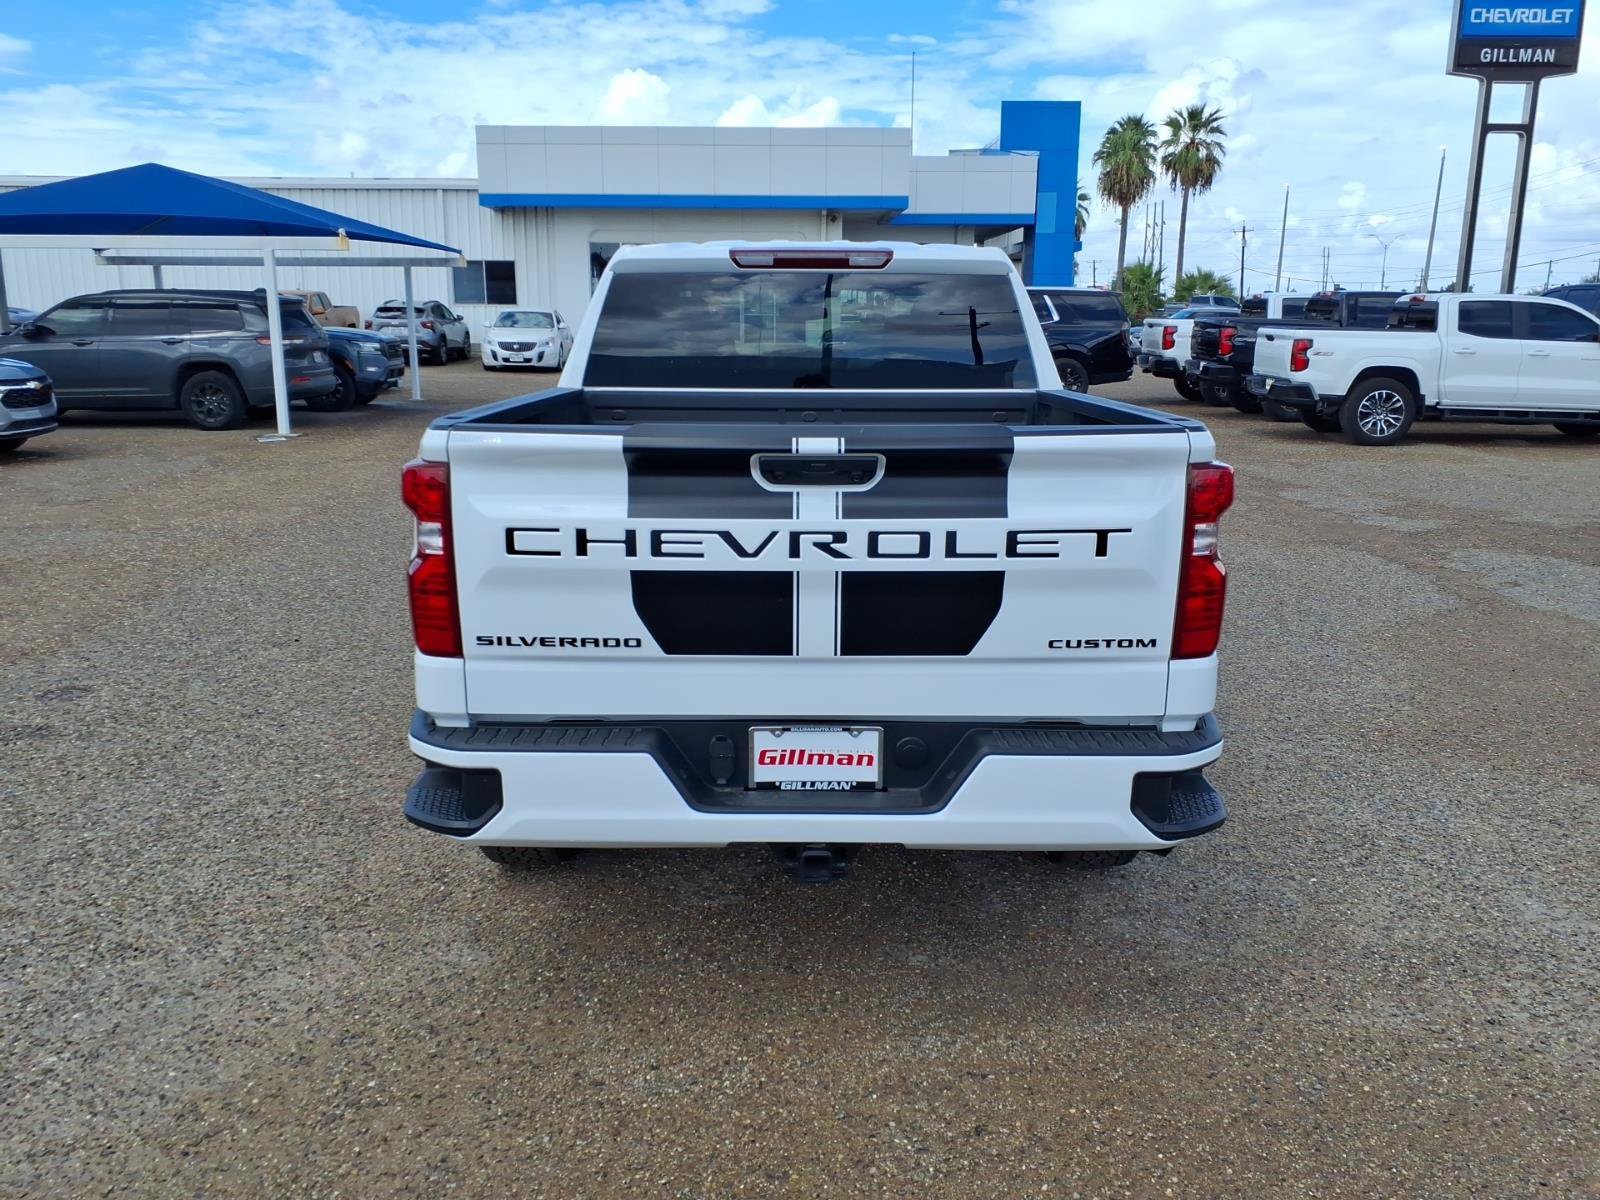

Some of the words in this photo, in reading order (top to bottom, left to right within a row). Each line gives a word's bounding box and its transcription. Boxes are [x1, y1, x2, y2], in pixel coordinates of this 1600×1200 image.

[1470, 8, 1574, 24] CHEVROLET
[1480, 48, 1556, 63] GILLMAN
[505, 526, 1133, 559] CHEVROLET
[476, 635, 642, 649] SILVERADO
[1048, 638, 1157, 649] CUSTOM
[758, 749, 874, 766] Gillman
[780, 781, 851, 791] GILLMAN
